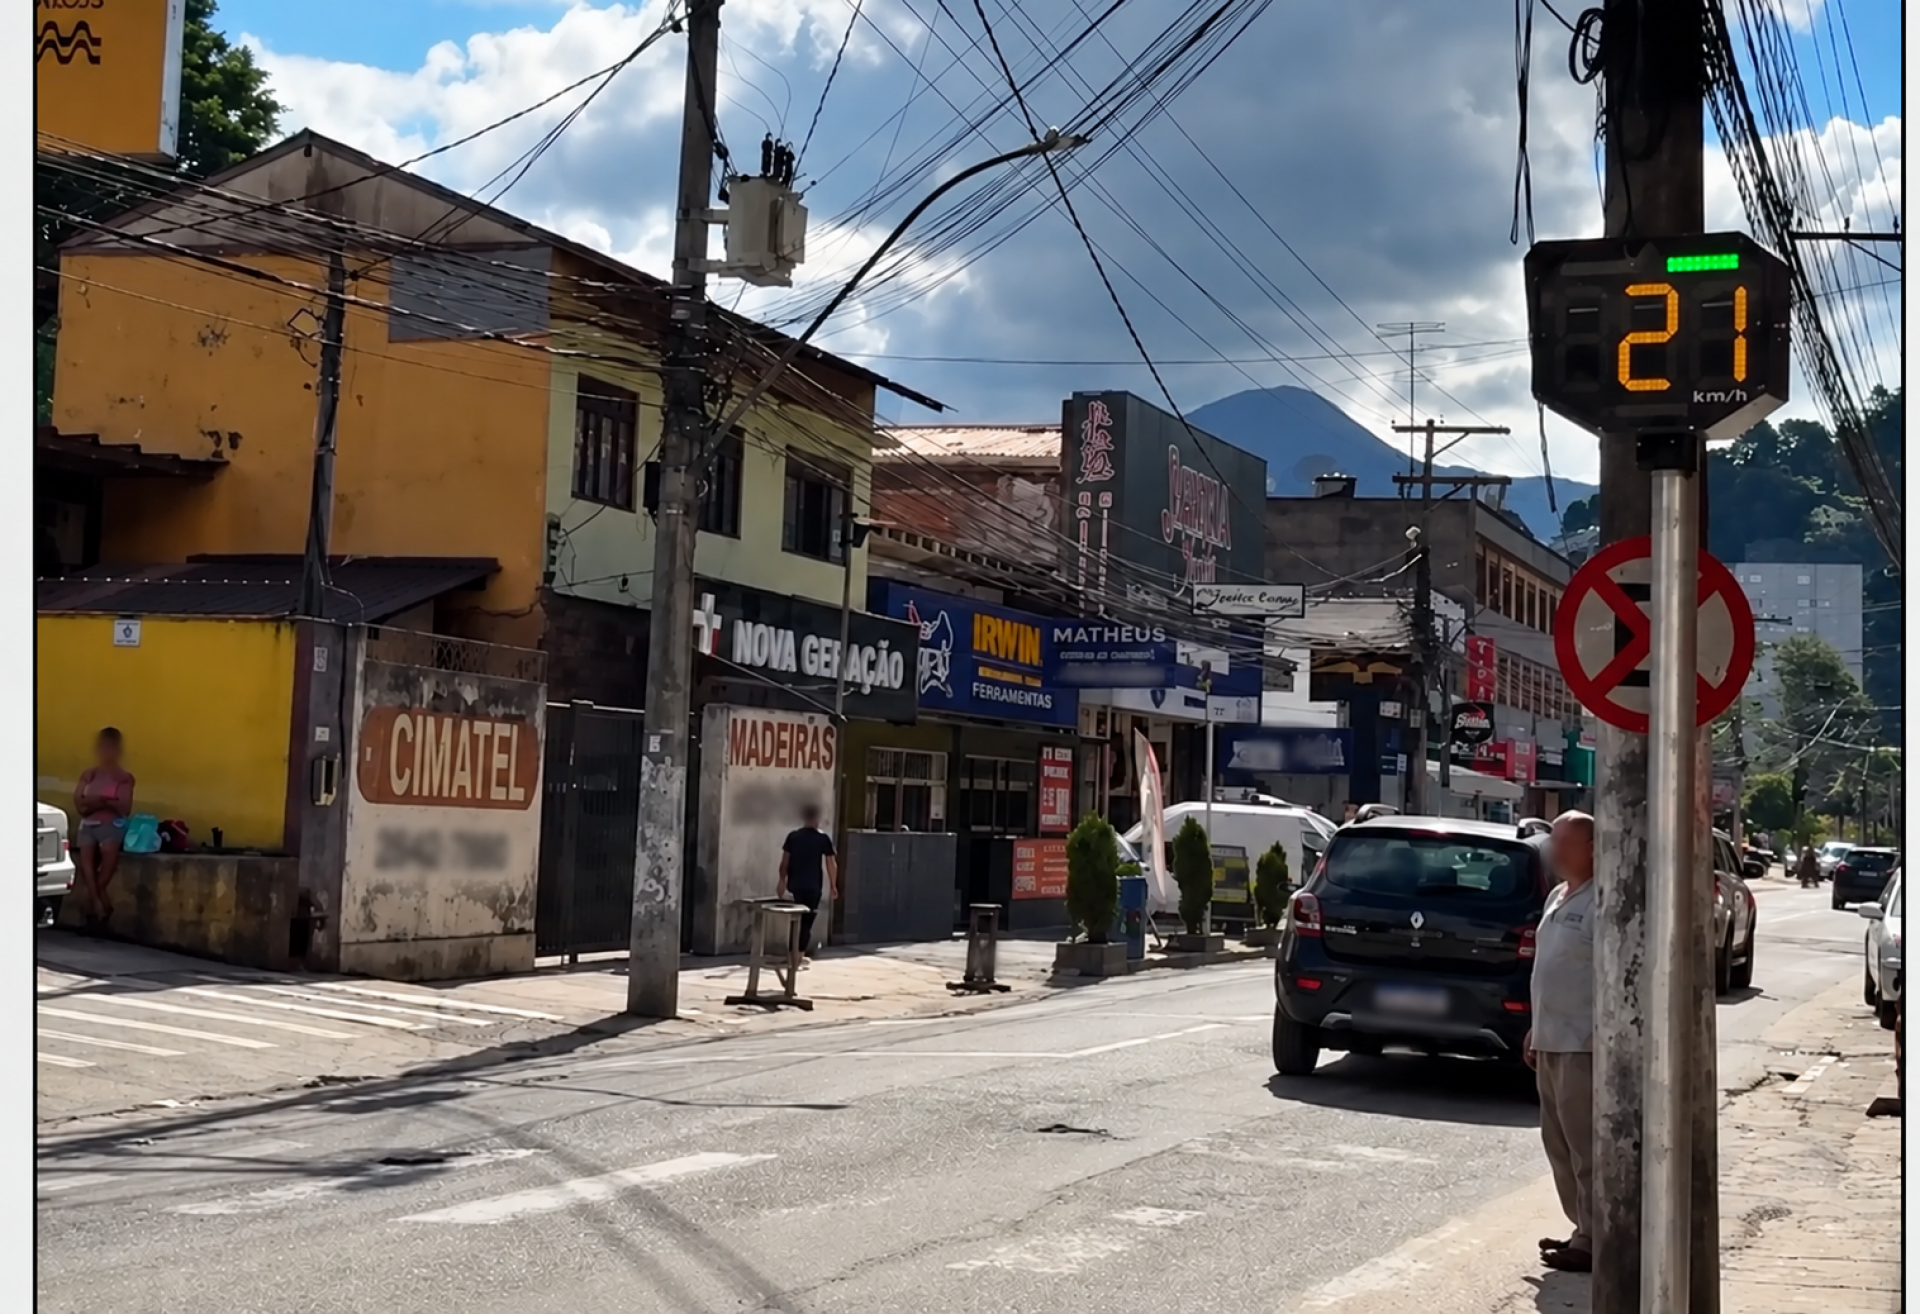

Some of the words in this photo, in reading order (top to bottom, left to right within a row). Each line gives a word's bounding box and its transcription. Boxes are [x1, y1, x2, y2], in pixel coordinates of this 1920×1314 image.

[1618, 283, 1747, 392] 21
[1693, 389, 1748, 403] km/h
[732, 619, 797, 673] NOVA
[973, 613, 1041, 666] IRWIN
[1053, 627, 1166, 643] MATHEUS
[972, 682, 1052, 709] FERRAMENTAS
[390, 713, 525, 801] CIMATEL
[730, 718, 834, 770] MADEIRAS
